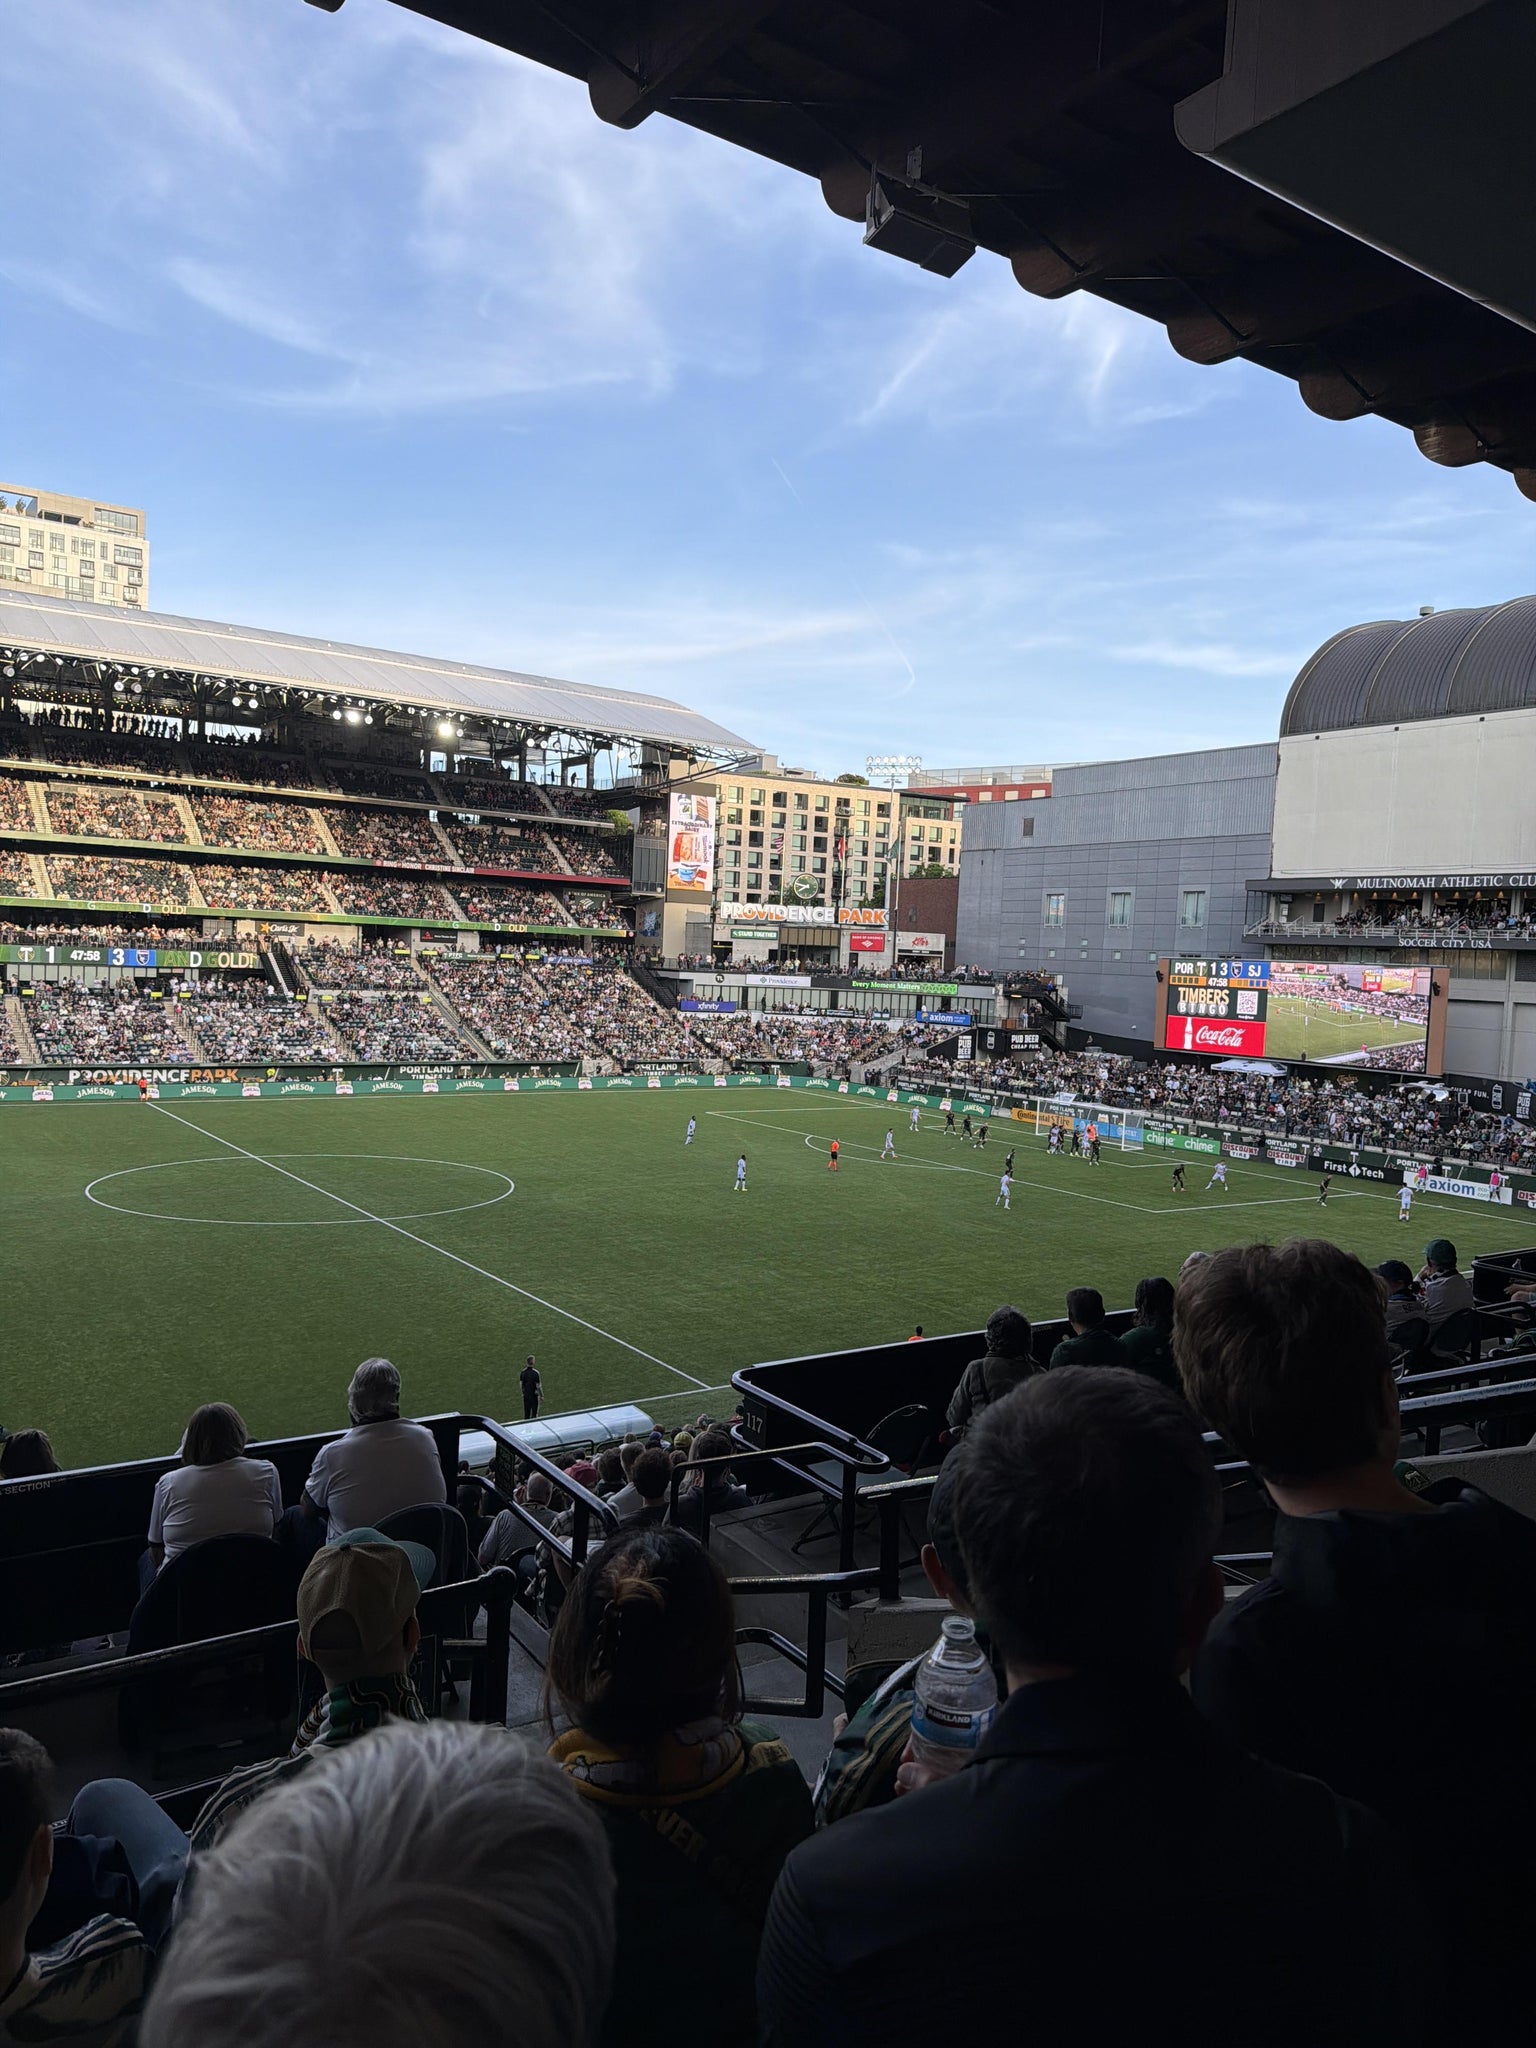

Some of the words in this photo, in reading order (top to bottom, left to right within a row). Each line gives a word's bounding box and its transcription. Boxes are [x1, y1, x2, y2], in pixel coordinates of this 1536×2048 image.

[1356, 878, 1435, 889] MULTNOMAH
[1440, 875, 1503, 888] ATHLETIC
[720, 902, 834, 923] PROVIDENCE
[838, 907, 889, 925] PARK
[1399, 938, 1437, 948] SOCCER
[1442, 939, 1466, 948] CITY
[1470, 940, 1492, 948] USA
[46, 946, 55, 963] 1
[70, 950, 101, 961] 47:58
[113, 948, 125, 966] 3
[1175, 962, 1194, 974] POR
[1210, 962, 1216, 975] 1
[1220, 963, 1228, 976] 3
[1248, 965, 1261, 977] SJ
[1208, 978, 1228, 987] 47:58
[1178, 987, 1230, 1005] TIMBERS
[698, 1002, 719, 1011] xfinity
[1179, 1001, 1227, 1015] BINGO
[930, 1014, 954, 1022] axiom
[1011, 1035, 1023, 1043] PUB
[1025, 1035, 1039, 1043] BEER
[1196, 1025, 1246, 1047] Coca-Cola
[958, 1039, 971, 1047] PUB
[456, 1080, 485, 1090] JAMESON
[534, 1078, 562, 1088] JAMESON
[607, 1077, 632, 1087] JAMESON
[674, 1077, 698, 1086] JAMESON
[739, 1076, 761, 1085] JAMESON
[806, 1079, 829, 1088] JAMESON
[181, 1086, 217, 1096] JAMESON
[281, 1083, 315, 1094] JAMESON
[372, 1081, 404, 1092] JAMESON
[857, 1086, 876, 1096] JAMESON
[76, 1087, 117, 1098] JAMESON
[969, 1092, 990, 1100] PORTLAND
[908, 1094, 928, 1105] JAMESON
[1517, 1096, 1530, 1106] PUB
[962, 1104, 986, 1114] JAMESON
[1517, 1106, 1530, 1114] BEER
[1017, 1110, 1050, 1124] Continental
[1056, 1117, 1070, 1126] Tire
[1144, 1120, 1173, 1129] PORTLAND
[1146, 1131, 1174, 1145] chime
[1184, 1139, 1213, 1152] chime
[1222, 1143, 1259, 1155] DISCOUNT
[1266, 1150, 1305, 1162] DISCOUNT
[1324, 1160, 1347, 1174] First
[1361, 1166, 1384, 1179] Tech
[1397, 1159, 1433, 1170] PORTLN
[1429, 1178, 1475, 1196] axiom
[4, 1480, 51, 1495] SECTION
[927, 1706, 971, 1724] KIRKLAND
